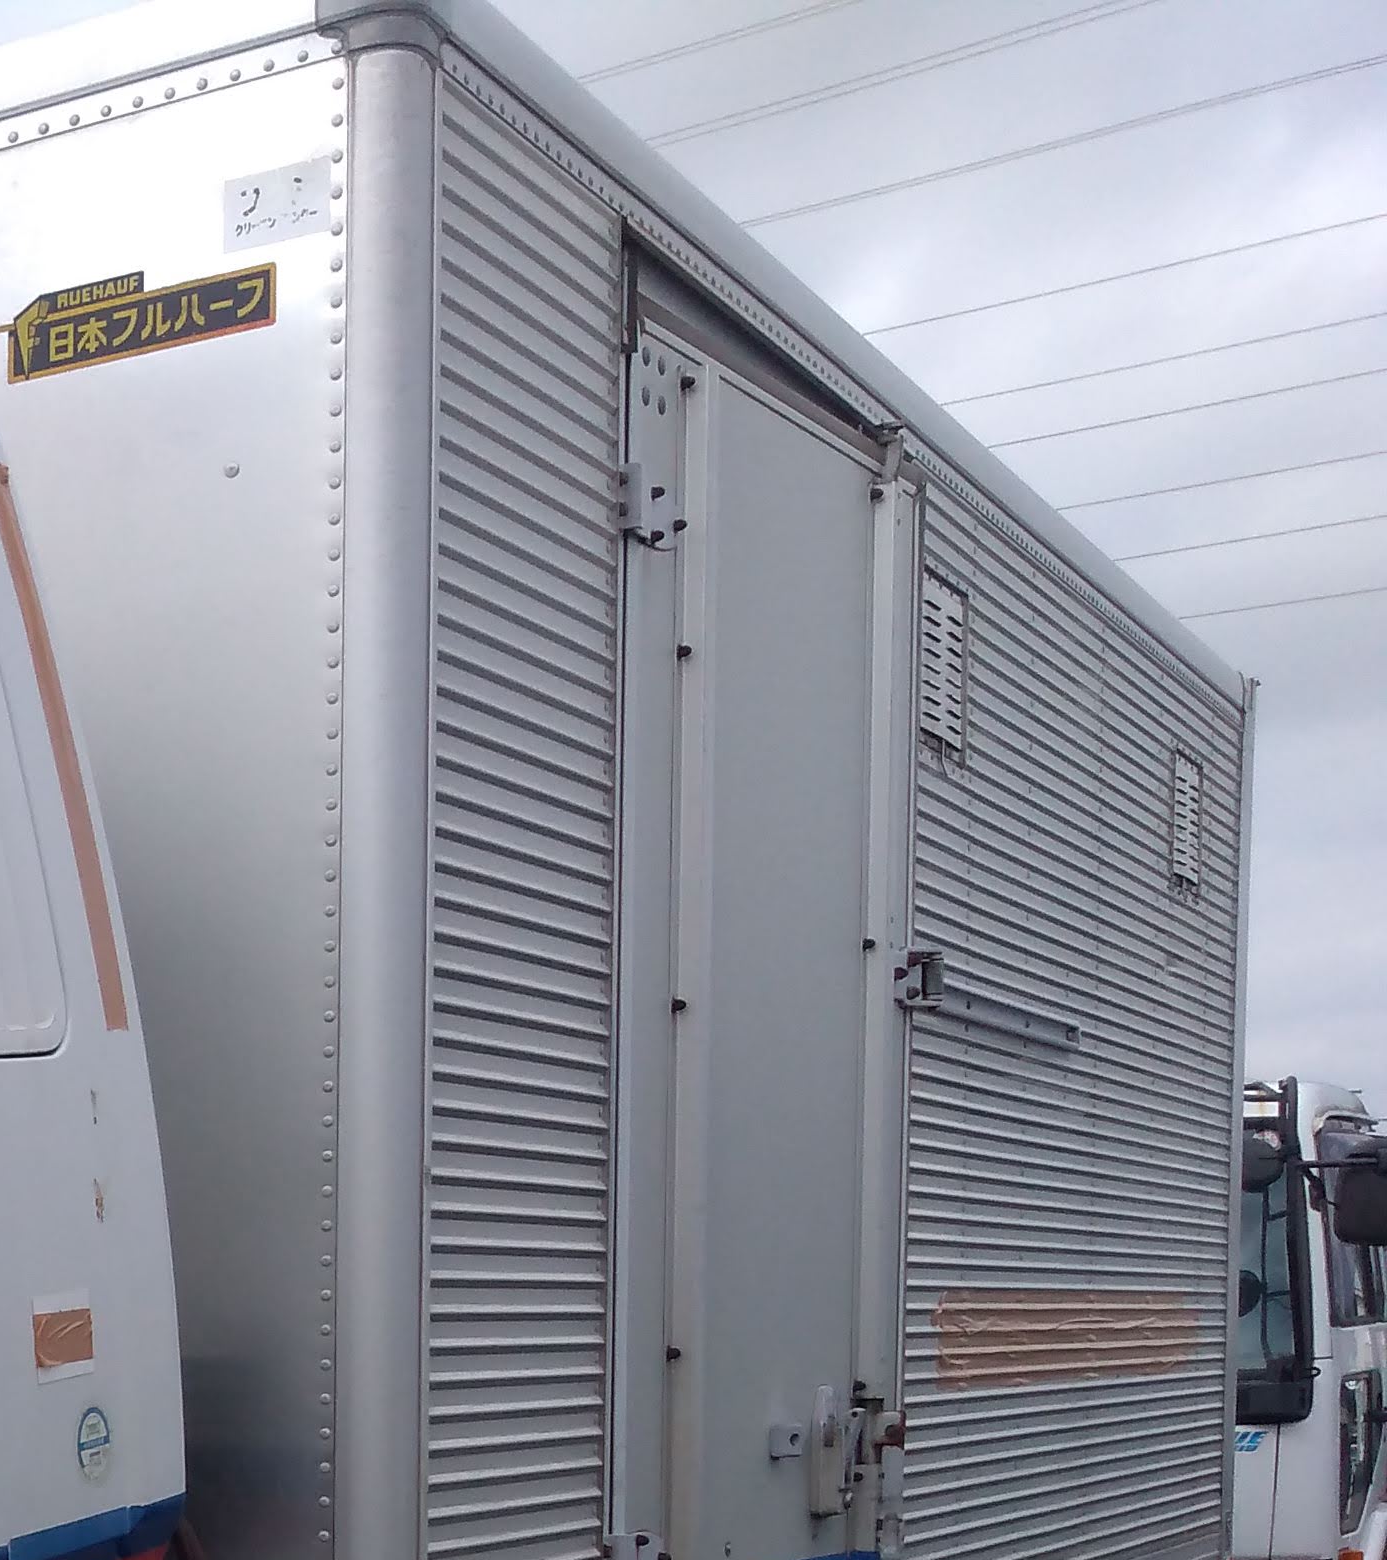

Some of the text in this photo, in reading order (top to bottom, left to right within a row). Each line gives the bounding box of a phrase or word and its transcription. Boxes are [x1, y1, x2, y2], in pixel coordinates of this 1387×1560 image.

[48, 276, 265, 364] 日本フルハーフ
